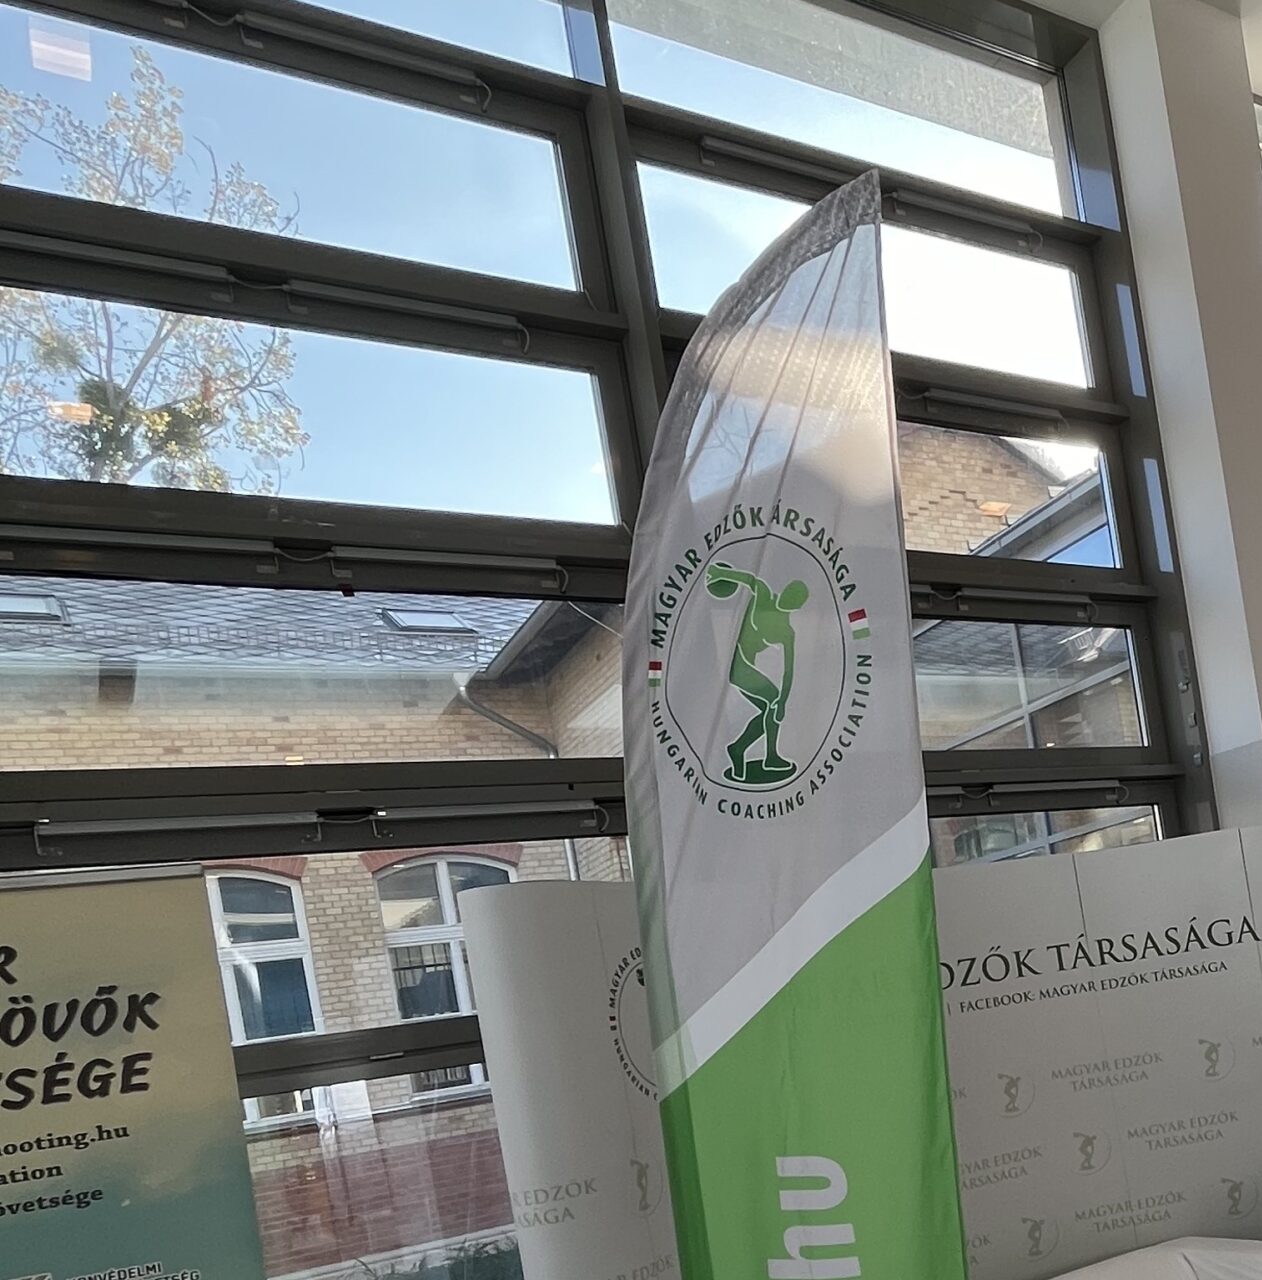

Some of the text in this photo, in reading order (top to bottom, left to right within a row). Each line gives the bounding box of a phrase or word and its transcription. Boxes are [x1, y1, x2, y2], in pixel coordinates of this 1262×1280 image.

[650, 498, 857, 648] MAGYAR EDZŐK ÁRSASÁGA
[717, 790, 805, 819] COACHING
[809, 653, 873, 795] ASSOCIATION
[939, 915, 1262, 991] DZŐK TÁRSASÁGA
[1038, 980, 1098, 1001] MAGYAR
[1151, 960, 1229, 983] TÁRSASÁGA
[0, 1052, 153, 1111] SÉGE
[1050, 1060, 1112, 1081] MAGYAR
[0, 1124, 130, 1156] ooting.hu
[1127, 1119, 1187, 1140] MAGYAR
